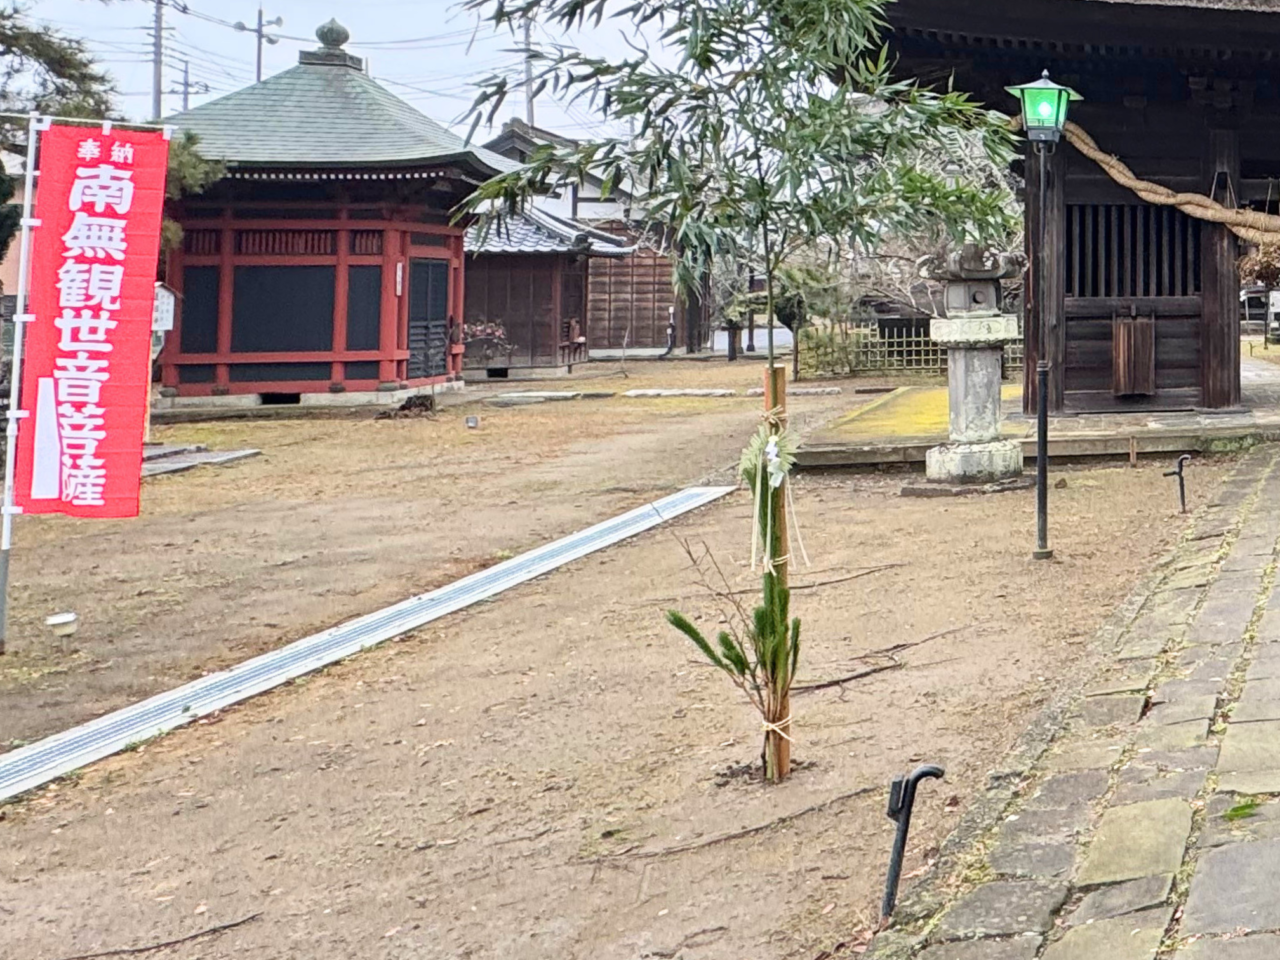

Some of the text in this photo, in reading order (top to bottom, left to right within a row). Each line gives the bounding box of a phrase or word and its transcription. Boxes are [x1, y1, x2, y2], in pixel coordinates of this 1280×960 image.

[77, 138, 134, 163] 奉納
[54, 163, 135, 506] 南無観世音菩薩
